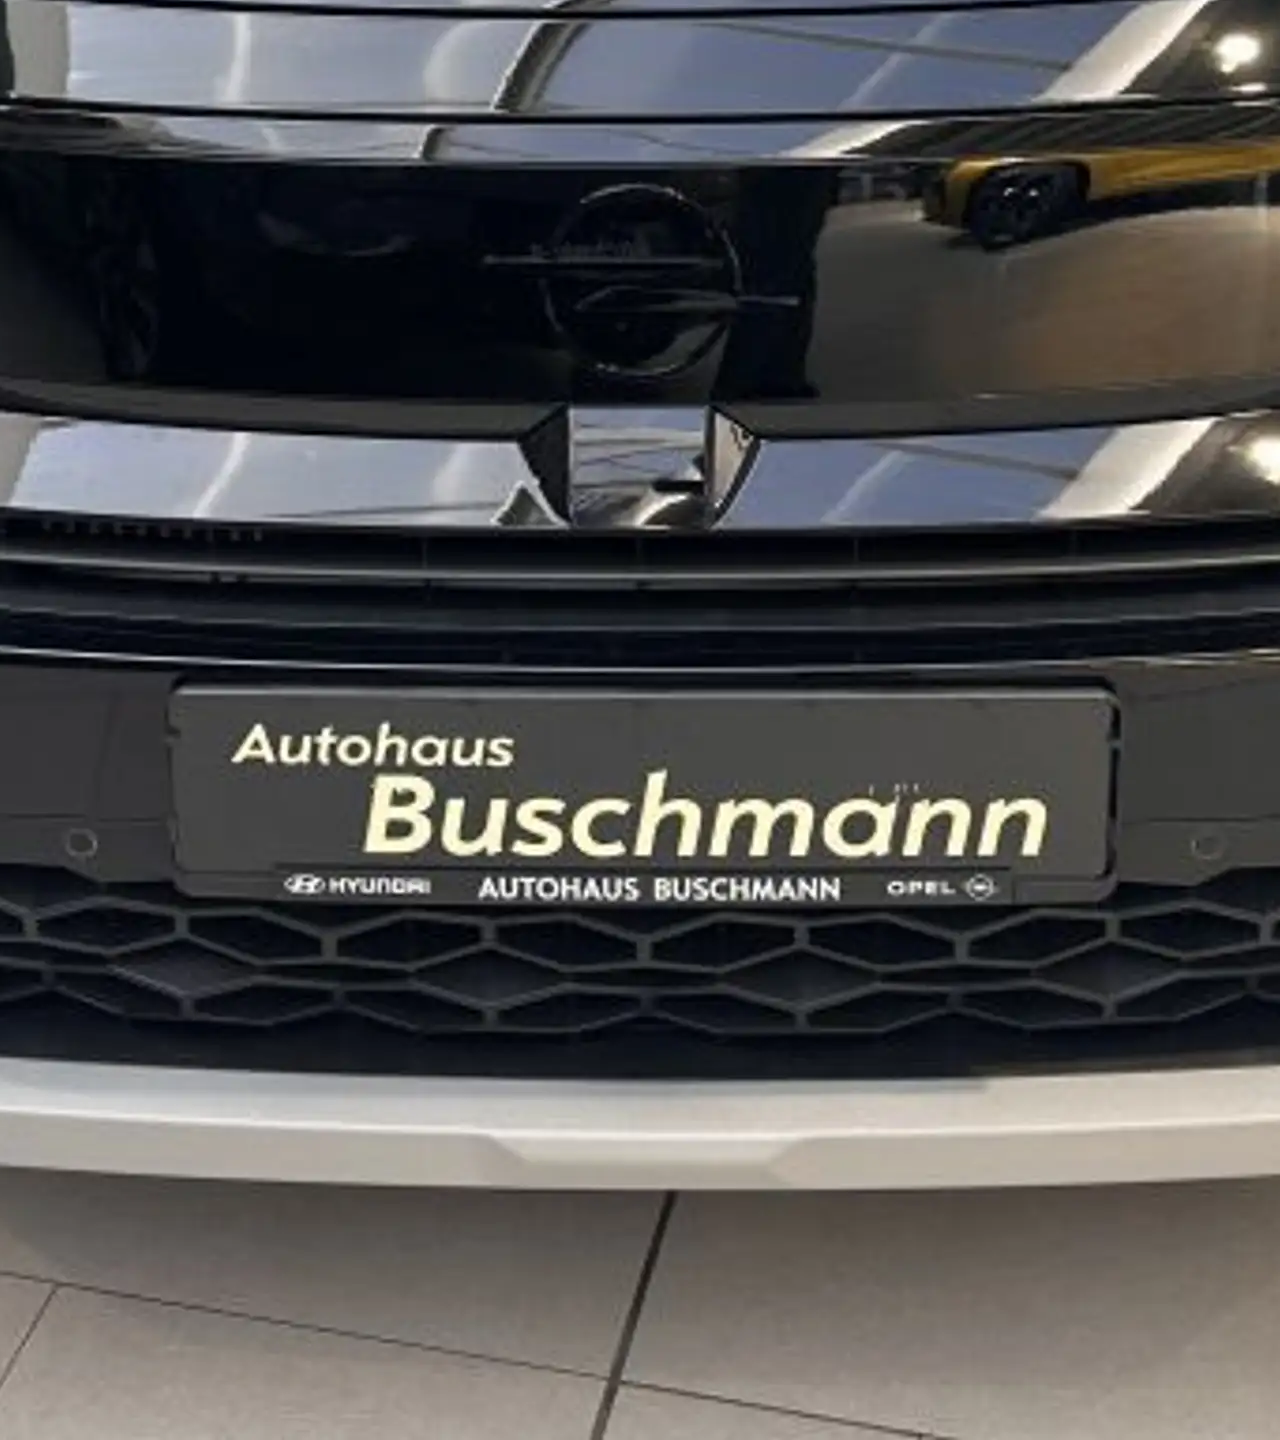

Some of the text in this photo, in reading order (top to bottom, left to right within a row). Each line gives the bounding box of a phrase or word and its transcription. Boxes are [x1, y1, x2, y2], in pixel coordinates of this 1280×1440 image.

[230, 721, 516, 768] Autohaus
[363, 767, 1048, 859] Buschmann
[328, 875, 957, 902] HYUNDAI AUTOHAUS BUSCHMANN OPEL
